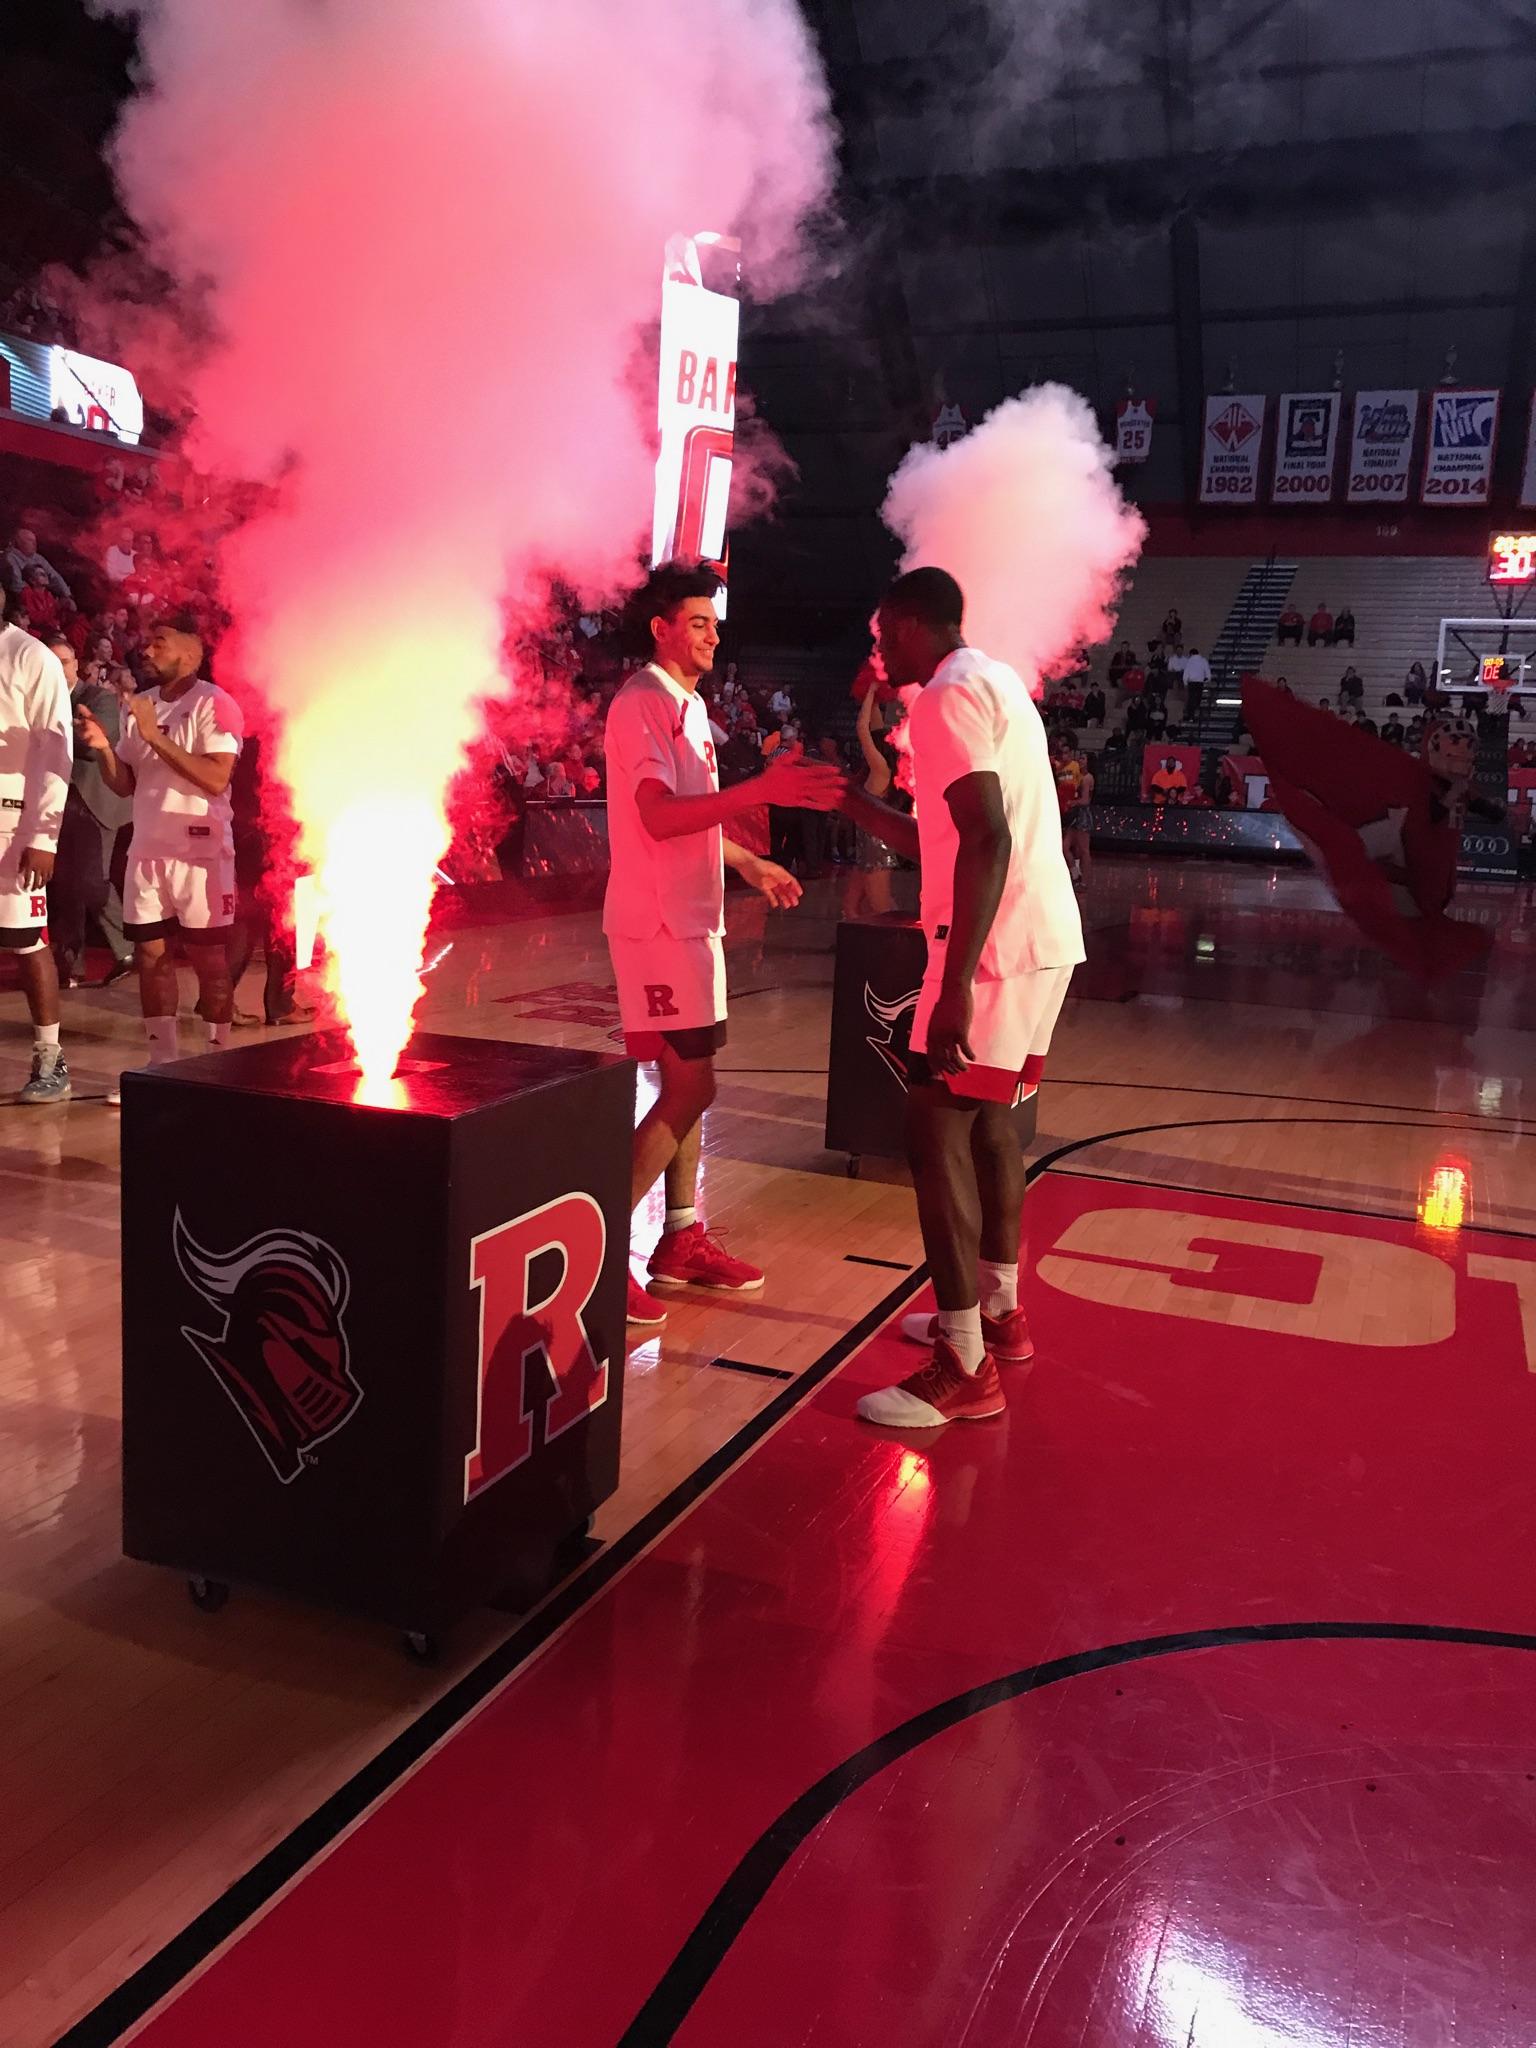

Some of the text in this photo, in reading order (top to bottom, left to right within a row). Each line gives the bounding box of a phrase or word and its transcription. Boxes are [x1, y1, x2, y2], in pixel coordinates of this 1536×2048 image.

[1123, 430, 1145, 449] 25
[1213, 455, 1249, 463] NATIONAL
[1437, 453, 1482, 461] NATIONAL
[1210, 465, 1251, 473] CHAMPION
[1433, 464, 1485, 472] CHAMPION
[1205, 477, 1253, 493] 1982
[1276, 475, 1330, 493] 2000
[1351, 473, 1407, 492] 2007
[1425, 478, 1486, 494] 2014
[1498, 551, 1531, 578] 30
[30, 895, 47, 918] R
[643, 984, 680, 1017] R
[464, 1190, 610, 1507] R
